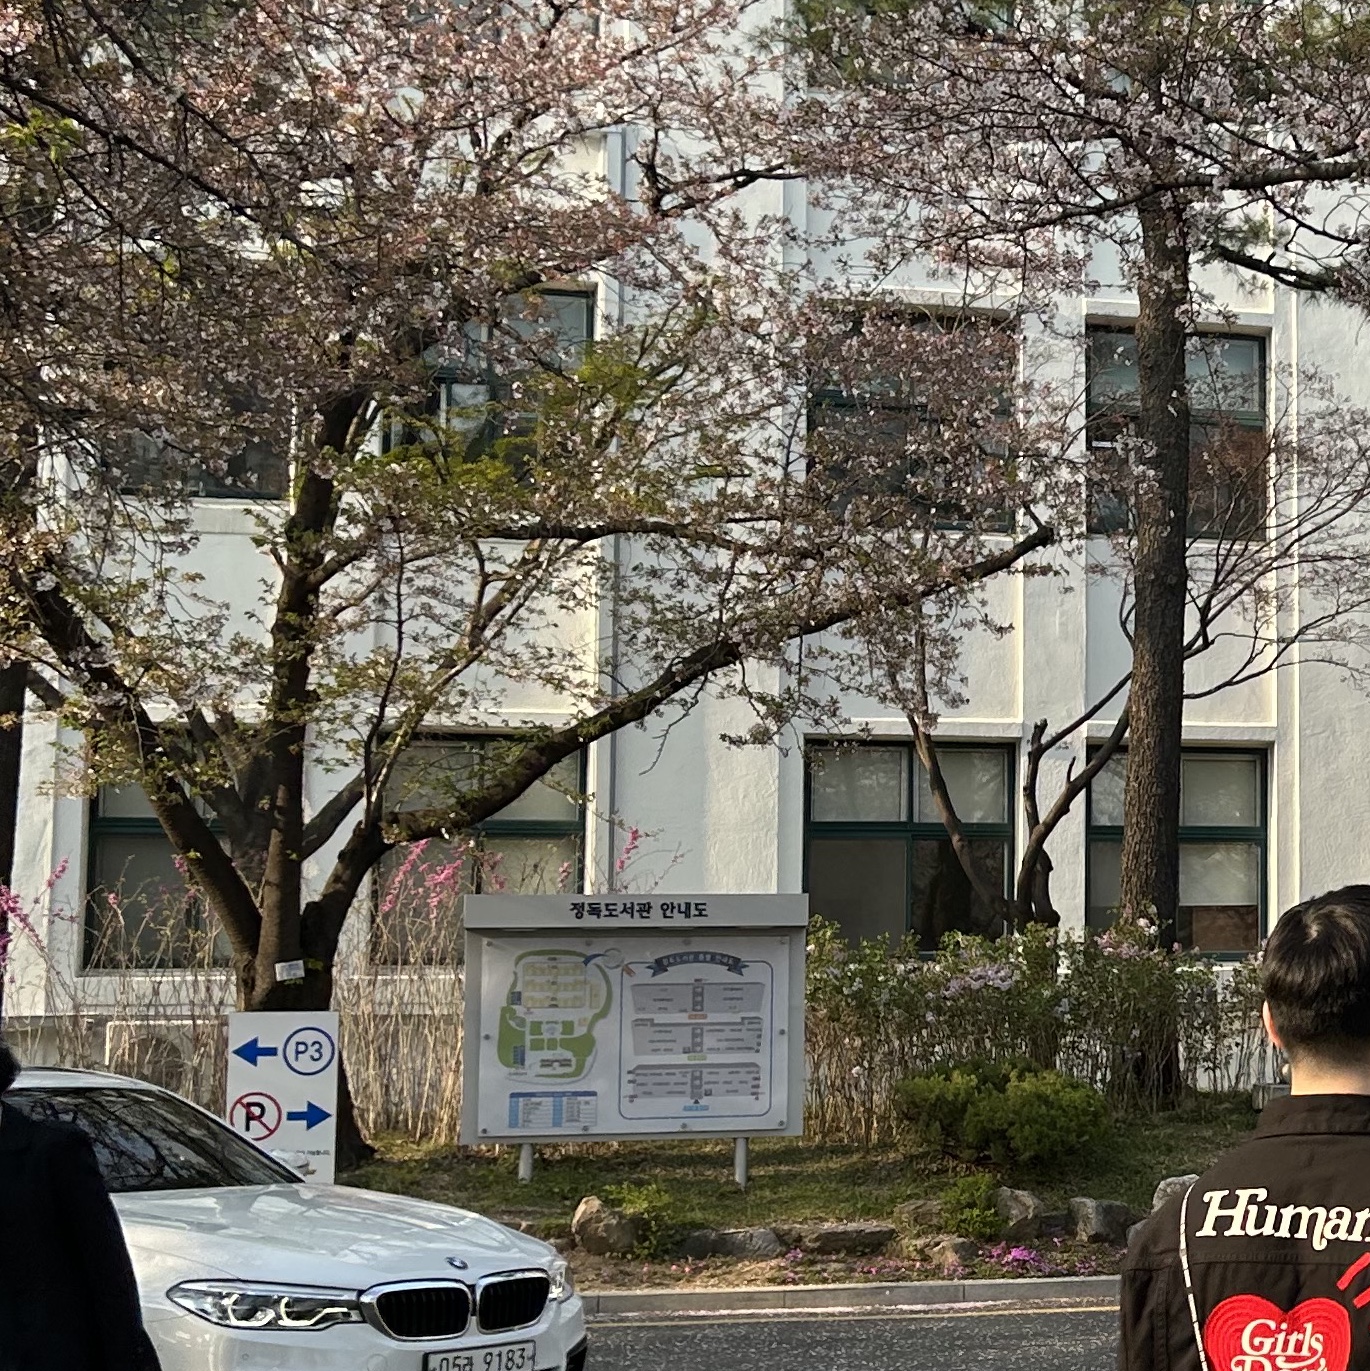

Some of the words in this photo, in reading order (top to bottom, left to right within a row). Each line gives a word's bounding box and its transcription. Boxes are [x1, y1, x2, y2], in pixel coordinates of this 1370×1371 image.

[570, 902, 653, 920] 정독도서관
[661, 902, 709, 919] 안내도
[294, 1040, 323, 1062] P3
[245, 1102, 266, 1132] P
[1241, 1319, 1324, 1369] Girls
